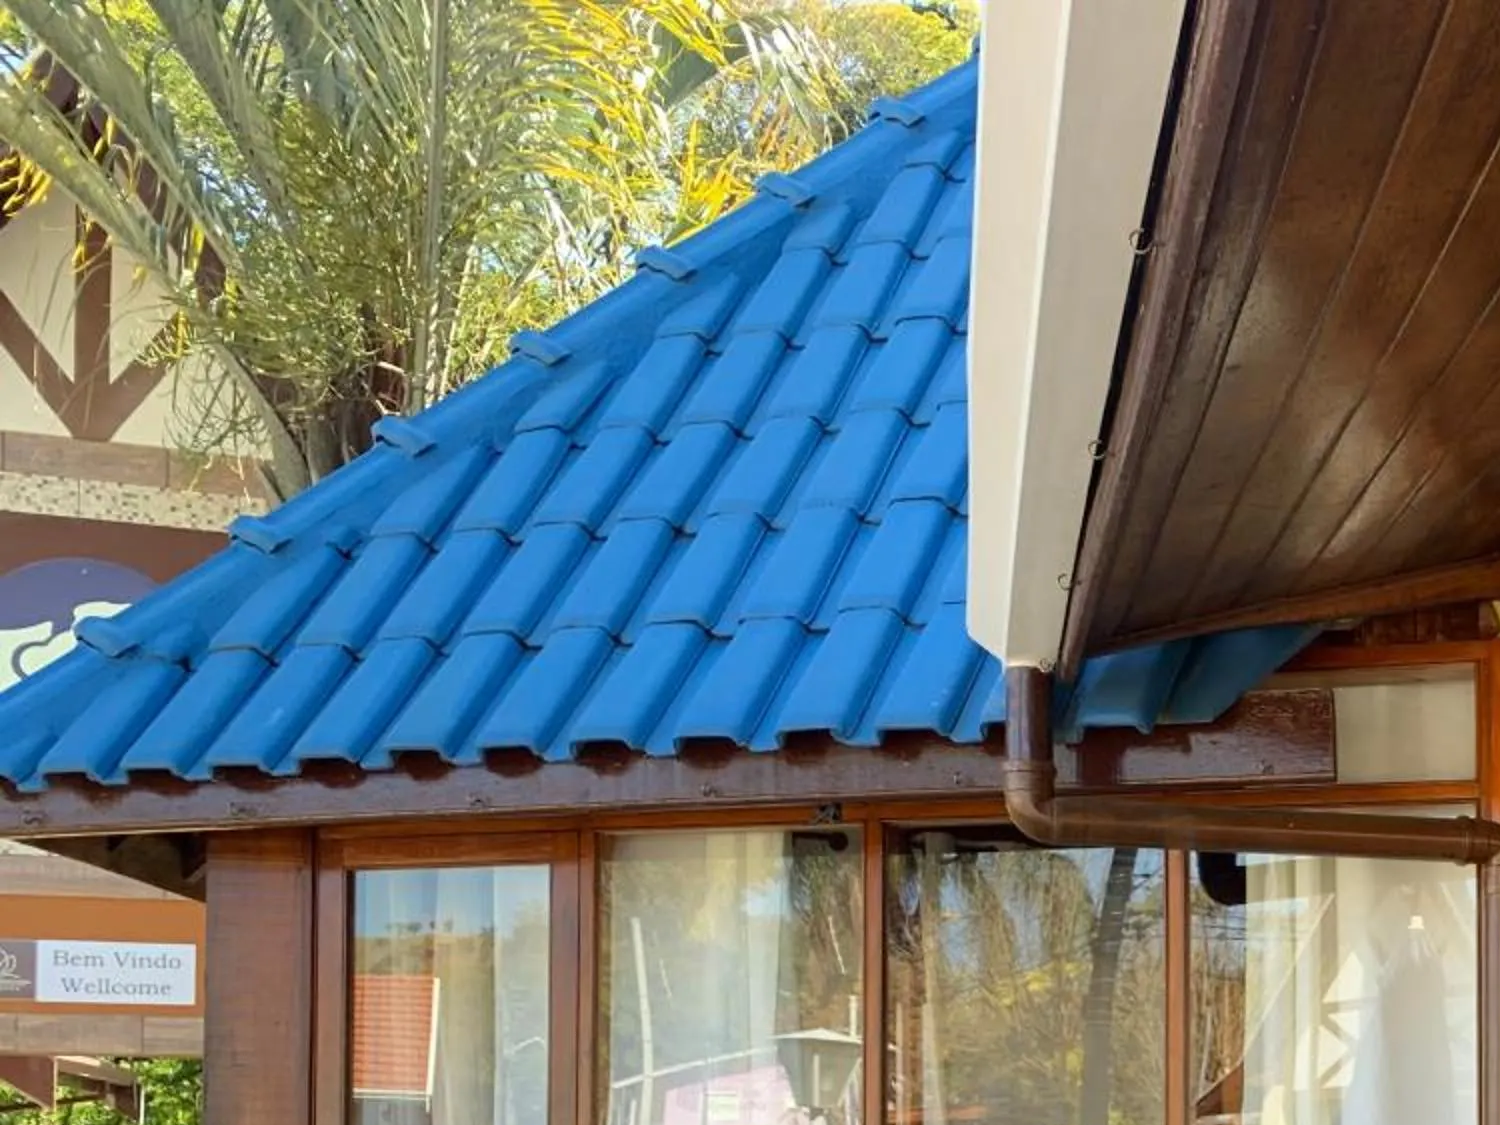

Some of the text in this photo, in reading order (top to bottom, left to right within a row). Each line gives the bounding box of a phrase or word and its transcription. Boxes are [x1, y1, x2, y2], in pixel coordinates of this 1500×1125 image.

[53, 949, 182, 969] Bem Vindo
[61, 977, 172, 996] Wellcome
